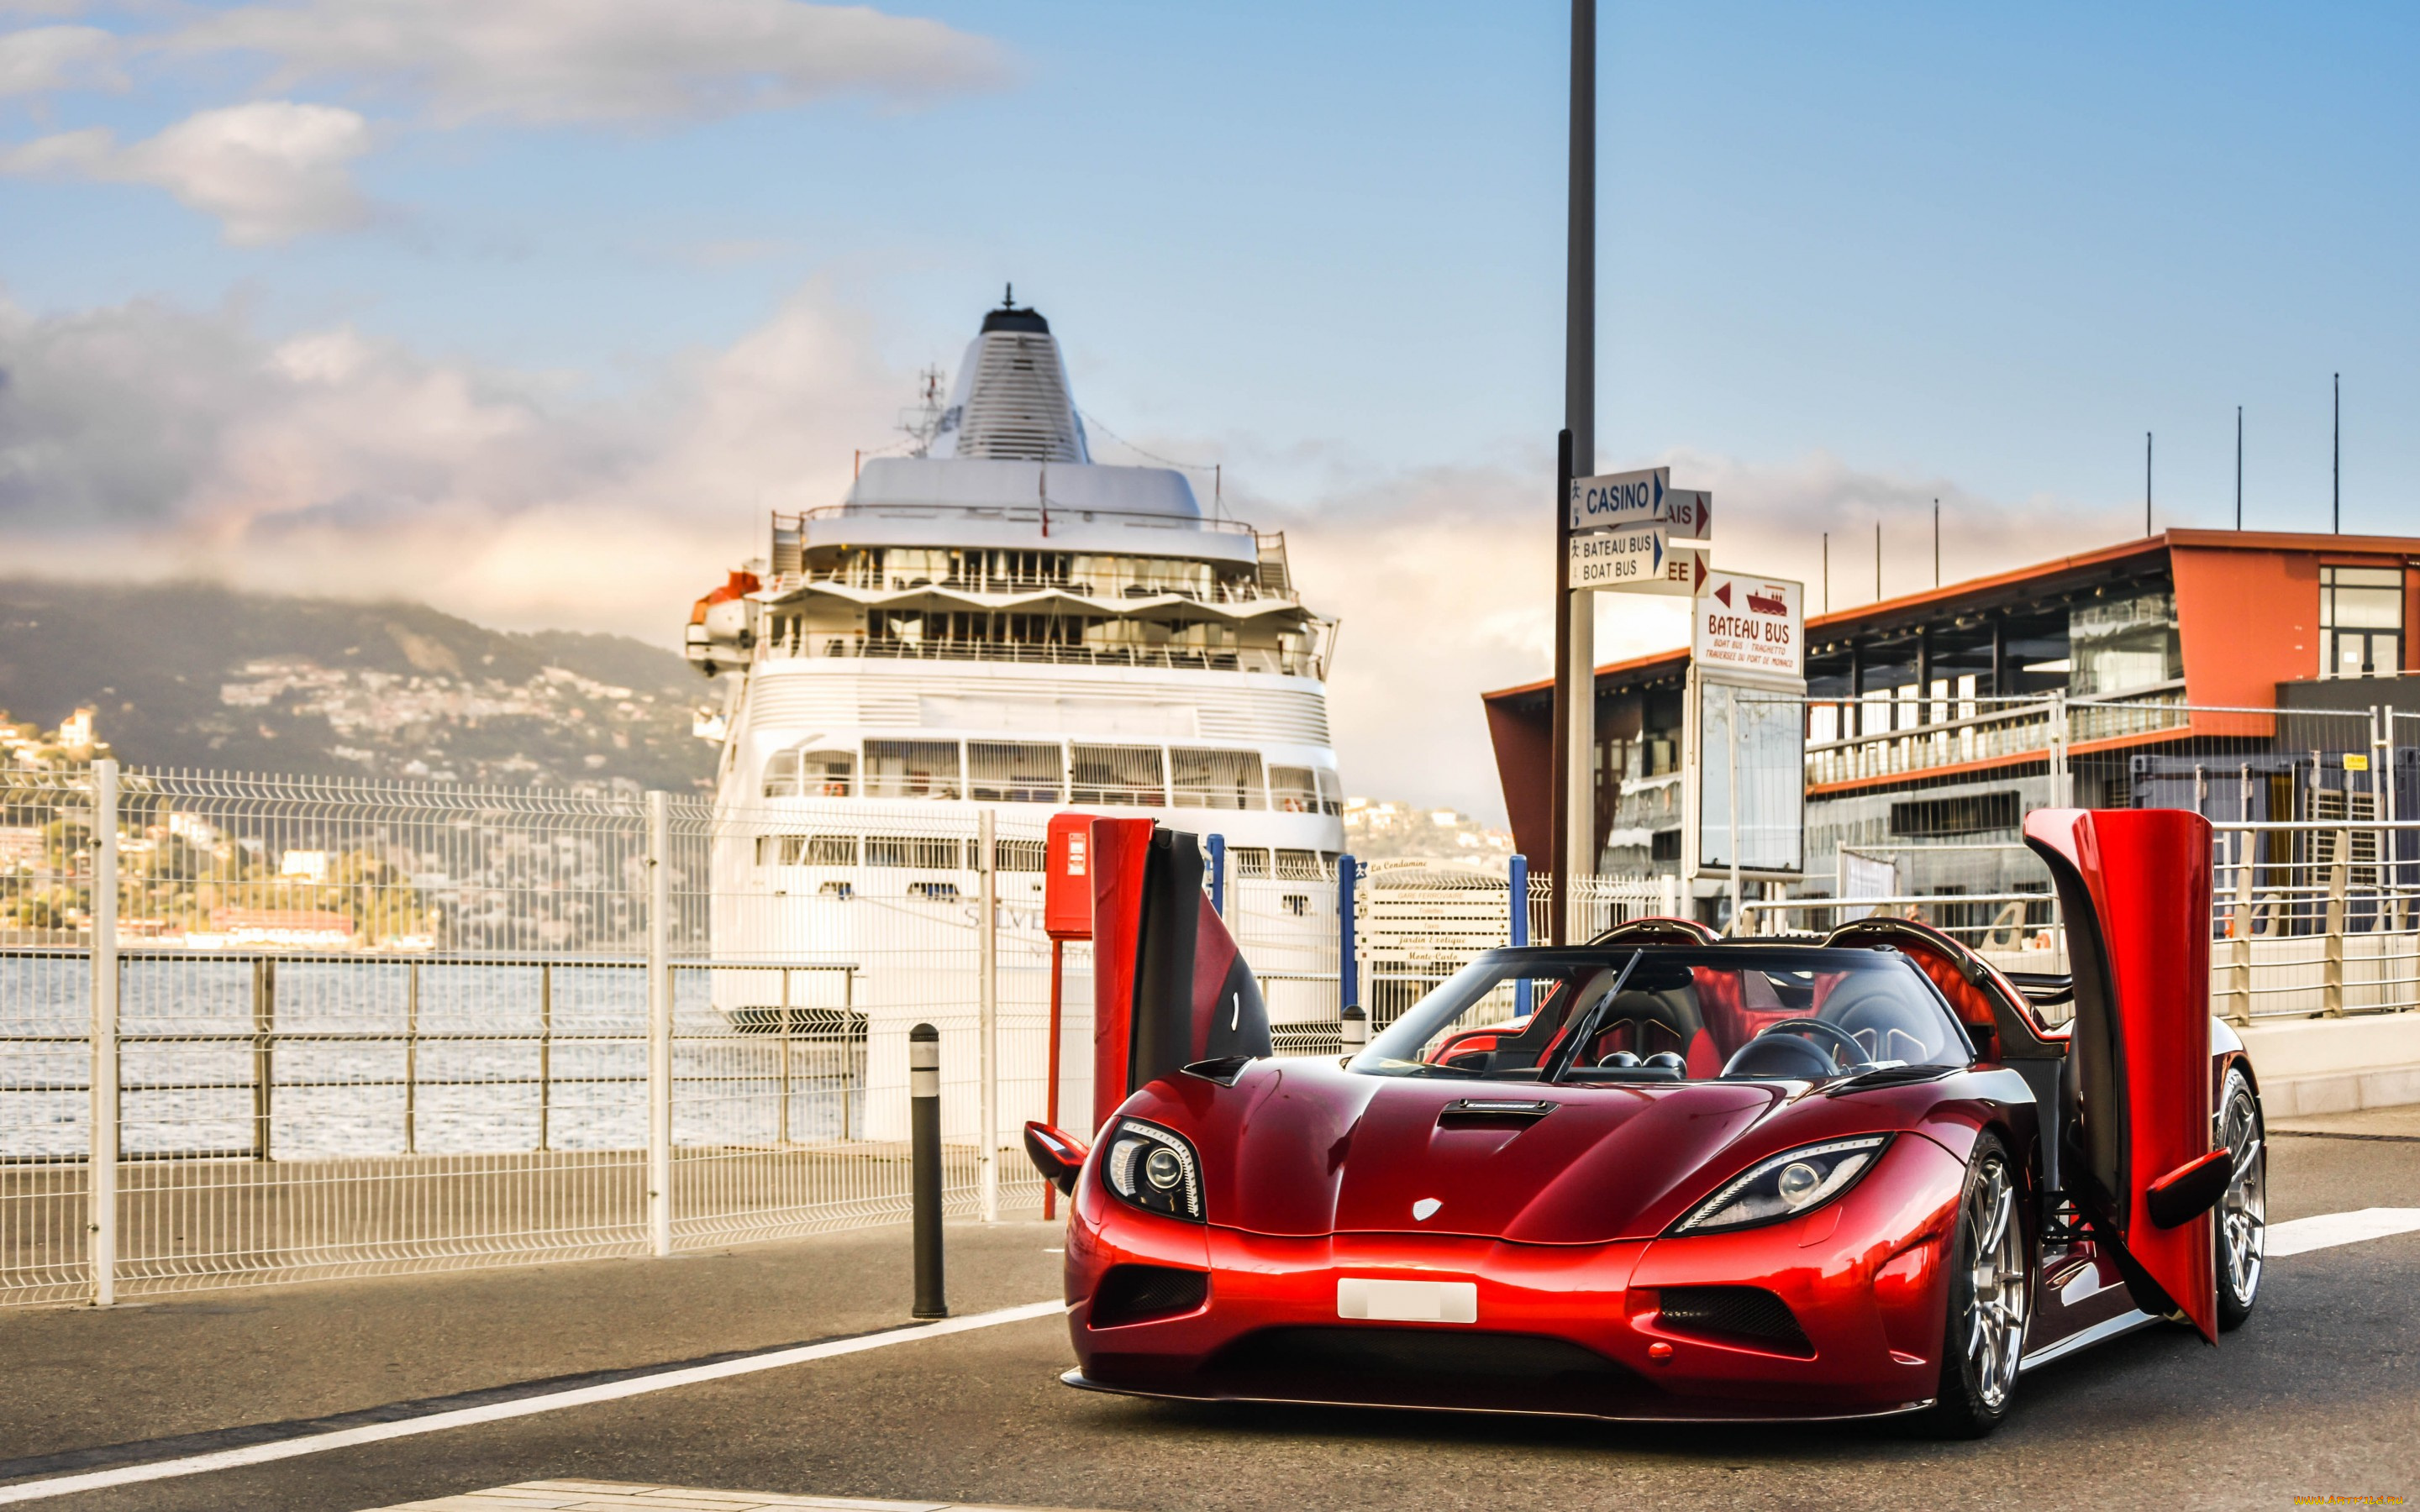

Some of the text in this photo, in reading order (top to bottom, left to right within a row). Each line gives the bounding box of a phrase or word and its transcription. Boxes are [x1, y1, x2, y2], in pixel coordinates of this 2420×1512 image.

[1586, 481, 1649, 514] CASINO
[1583, 535, 1651, 558] BATEAU BUS
[1583, 559, 1637, 580] BOAT BUS
[1708, 614, 1790, 644] BATEAU BUS
[1713, 638, 1730, 648] BOAT
[1731, 640, 1744, 649] BUS
[1747, 654, 1762, 664] PORT
[1762, 657, 1770, 665] DE
[1771, 659, 1794, 669] MONACO
[1370, 859, 1427, 873] La Condamine
[1408, 952, 1458, 960] Monte-Carlo
